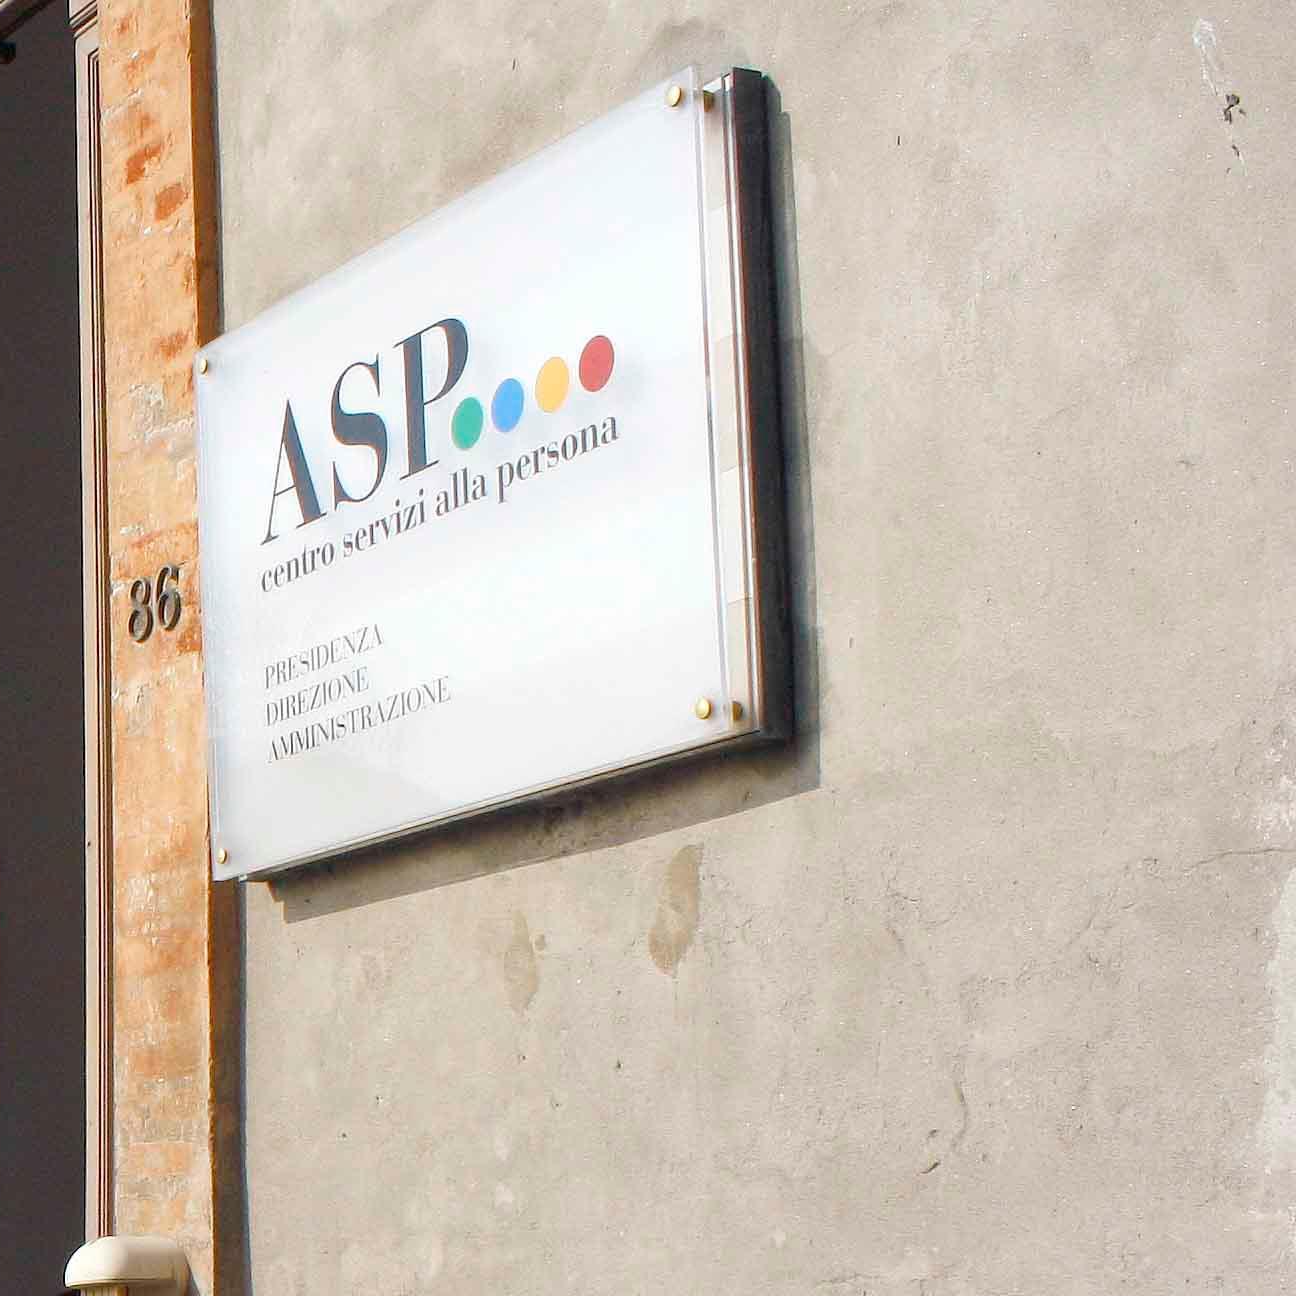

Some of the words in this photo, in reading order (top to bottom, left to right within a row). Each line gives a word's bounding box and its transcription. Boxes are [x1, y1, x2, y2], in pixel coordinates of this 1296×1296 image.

[260, 318, 469, 546] ASP
[261, 540, 335, 593] centro
[342, 488, 426, 559] servizi
[435, 467, 487, 517] alla
[496, 415, 620, 504] persona
[128, 564, 182, 643] 86
[264, 623, 385, 689] PRESIDENZA
[265, 666, 371, 727] DIREZIONE
[267, 675, 453, 763] AMMINISTRAZIONE
